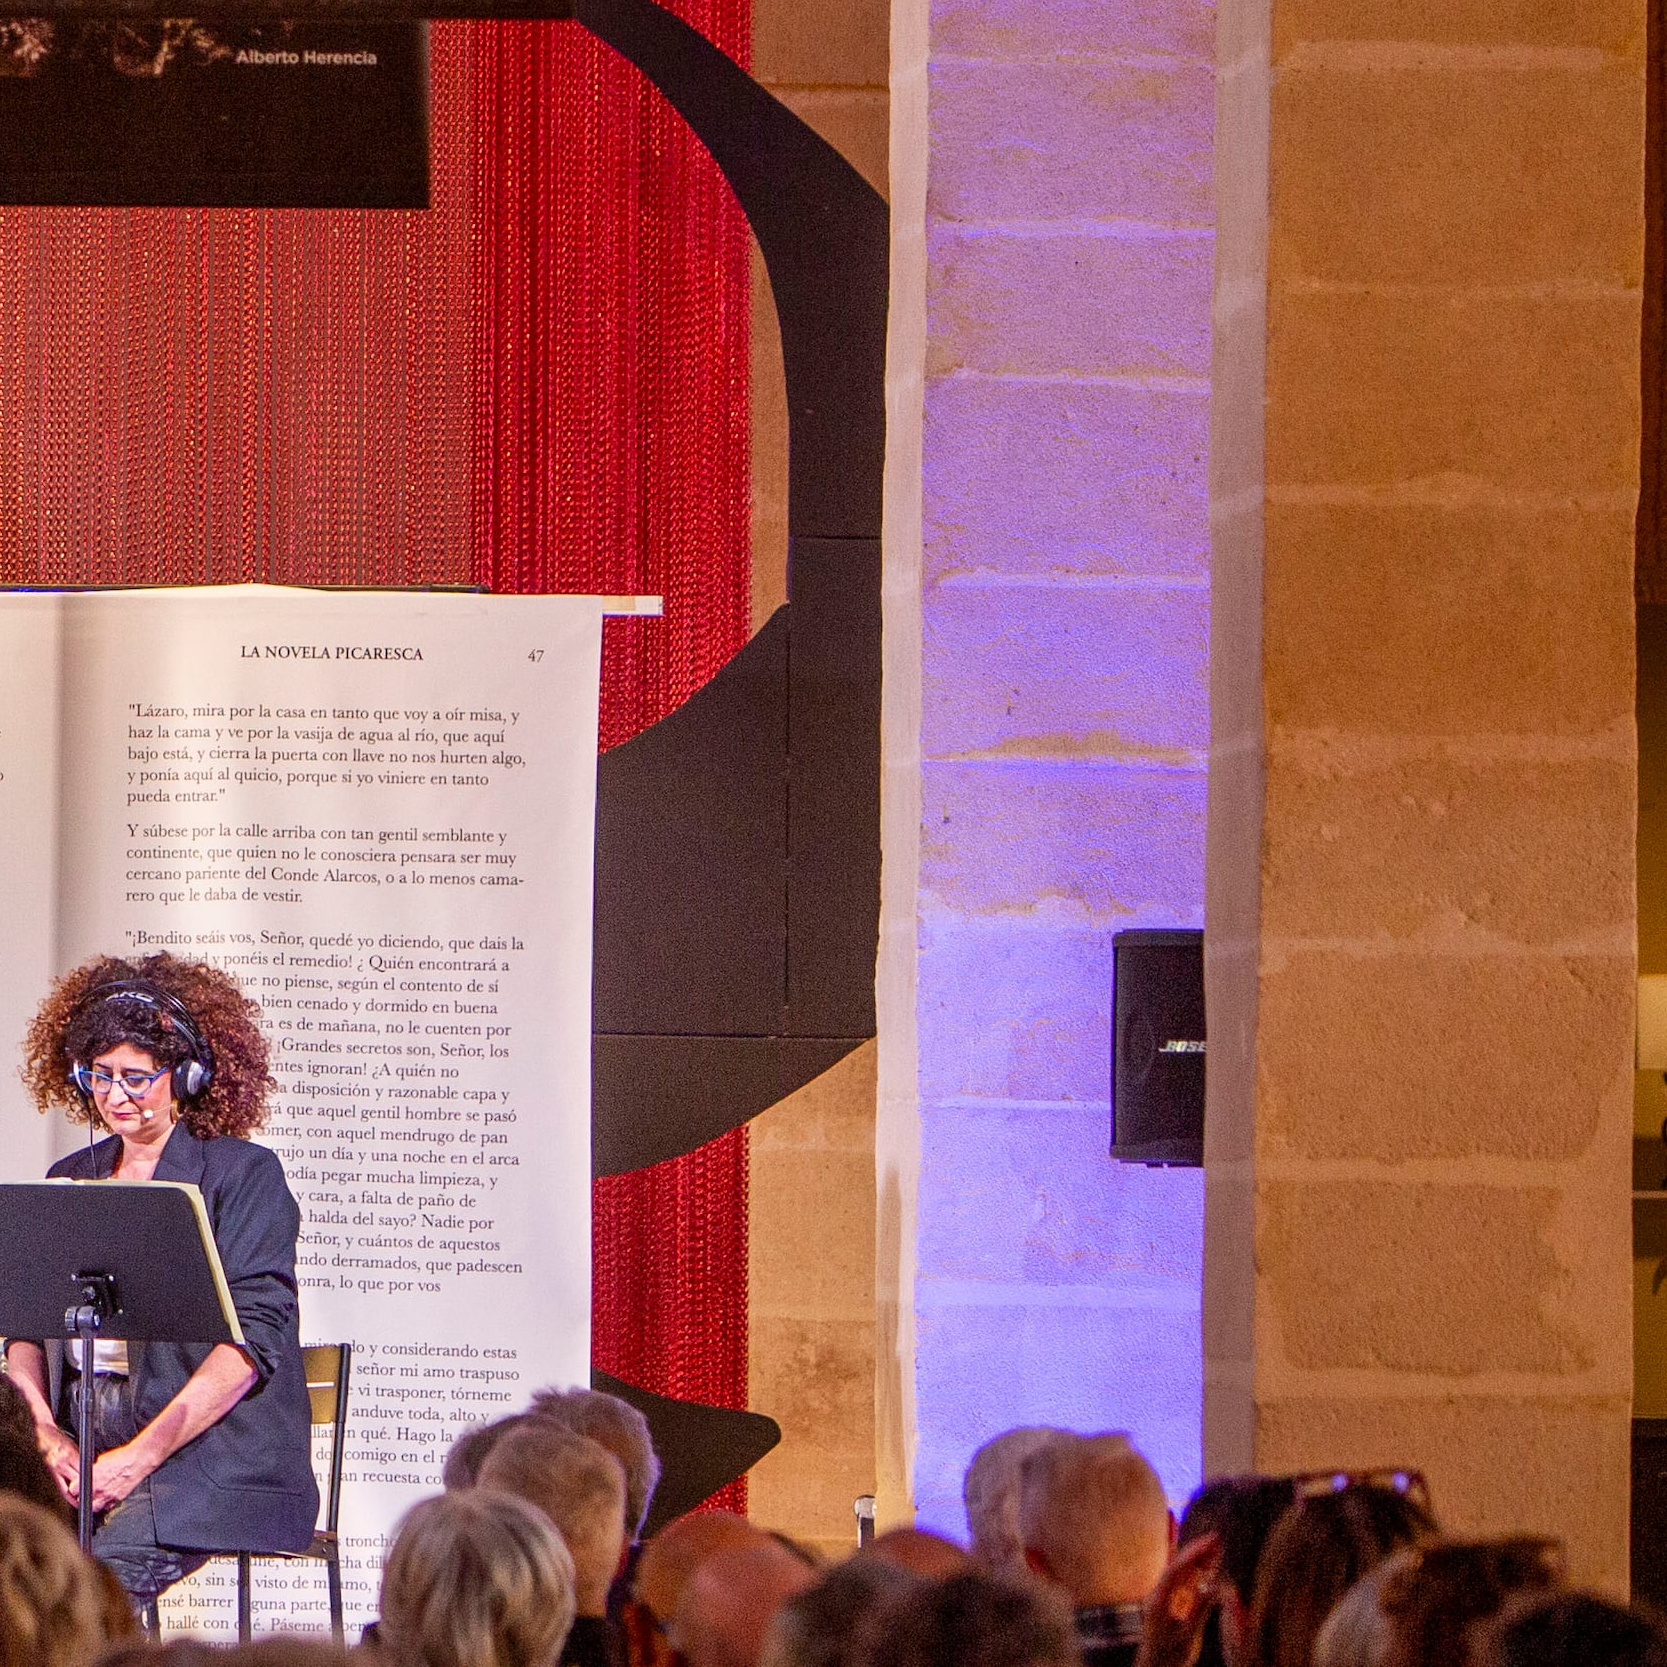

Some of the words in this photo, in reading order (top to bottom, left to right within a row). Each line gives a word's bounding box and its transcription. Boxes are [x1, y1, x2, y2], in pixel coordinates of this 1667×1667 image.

[236, 49, 300, 64] Alberto
[304, 50, 377, 65] Herencia
[241, 645, 260, 658] LA
[265, 646, 331, 659] NOVELA
[335, 647, 424, 661] PICARESCA
[527, 649, 545, 663] 47
[127, 788, 171, 807] pueda
[175, 788, 225, 802] entrar."
[126, 845, 203, 859] continente,
[207, 849, 232, 862] que
[236, 845, 277, 862] quien
[281, 850, 300, 860] no
[304, 847, 316, 860] le
[320, 848, 396, 862] conosciera
[401, 853, 456, 867] pensara
[460, 854, 481, 864] ser
[485, 854, 517, 868] muy
[126, 870, 181, 880] cercano
[185, 866, 240, 884] pariente
[245, 866, 266, 880] del
[271, 867, 319, 882] Conde
[323, 868, 381, 885] Alarcos,
[385, 874, 395, 883] o
[399, 874, 407, 884] a
[412, 870, 425, 884] lo
[429, 875, 475, 885] menos
[480, 876, 524, 886] cama-
[309, 1209, 348, 1224] halda
[352, 1211, 374, 1226] del
[378, 1214, 416, 1230] sayo?
[421, 1214, 464, 1229] Nadie
[469, 1220, 494, 1233] por
